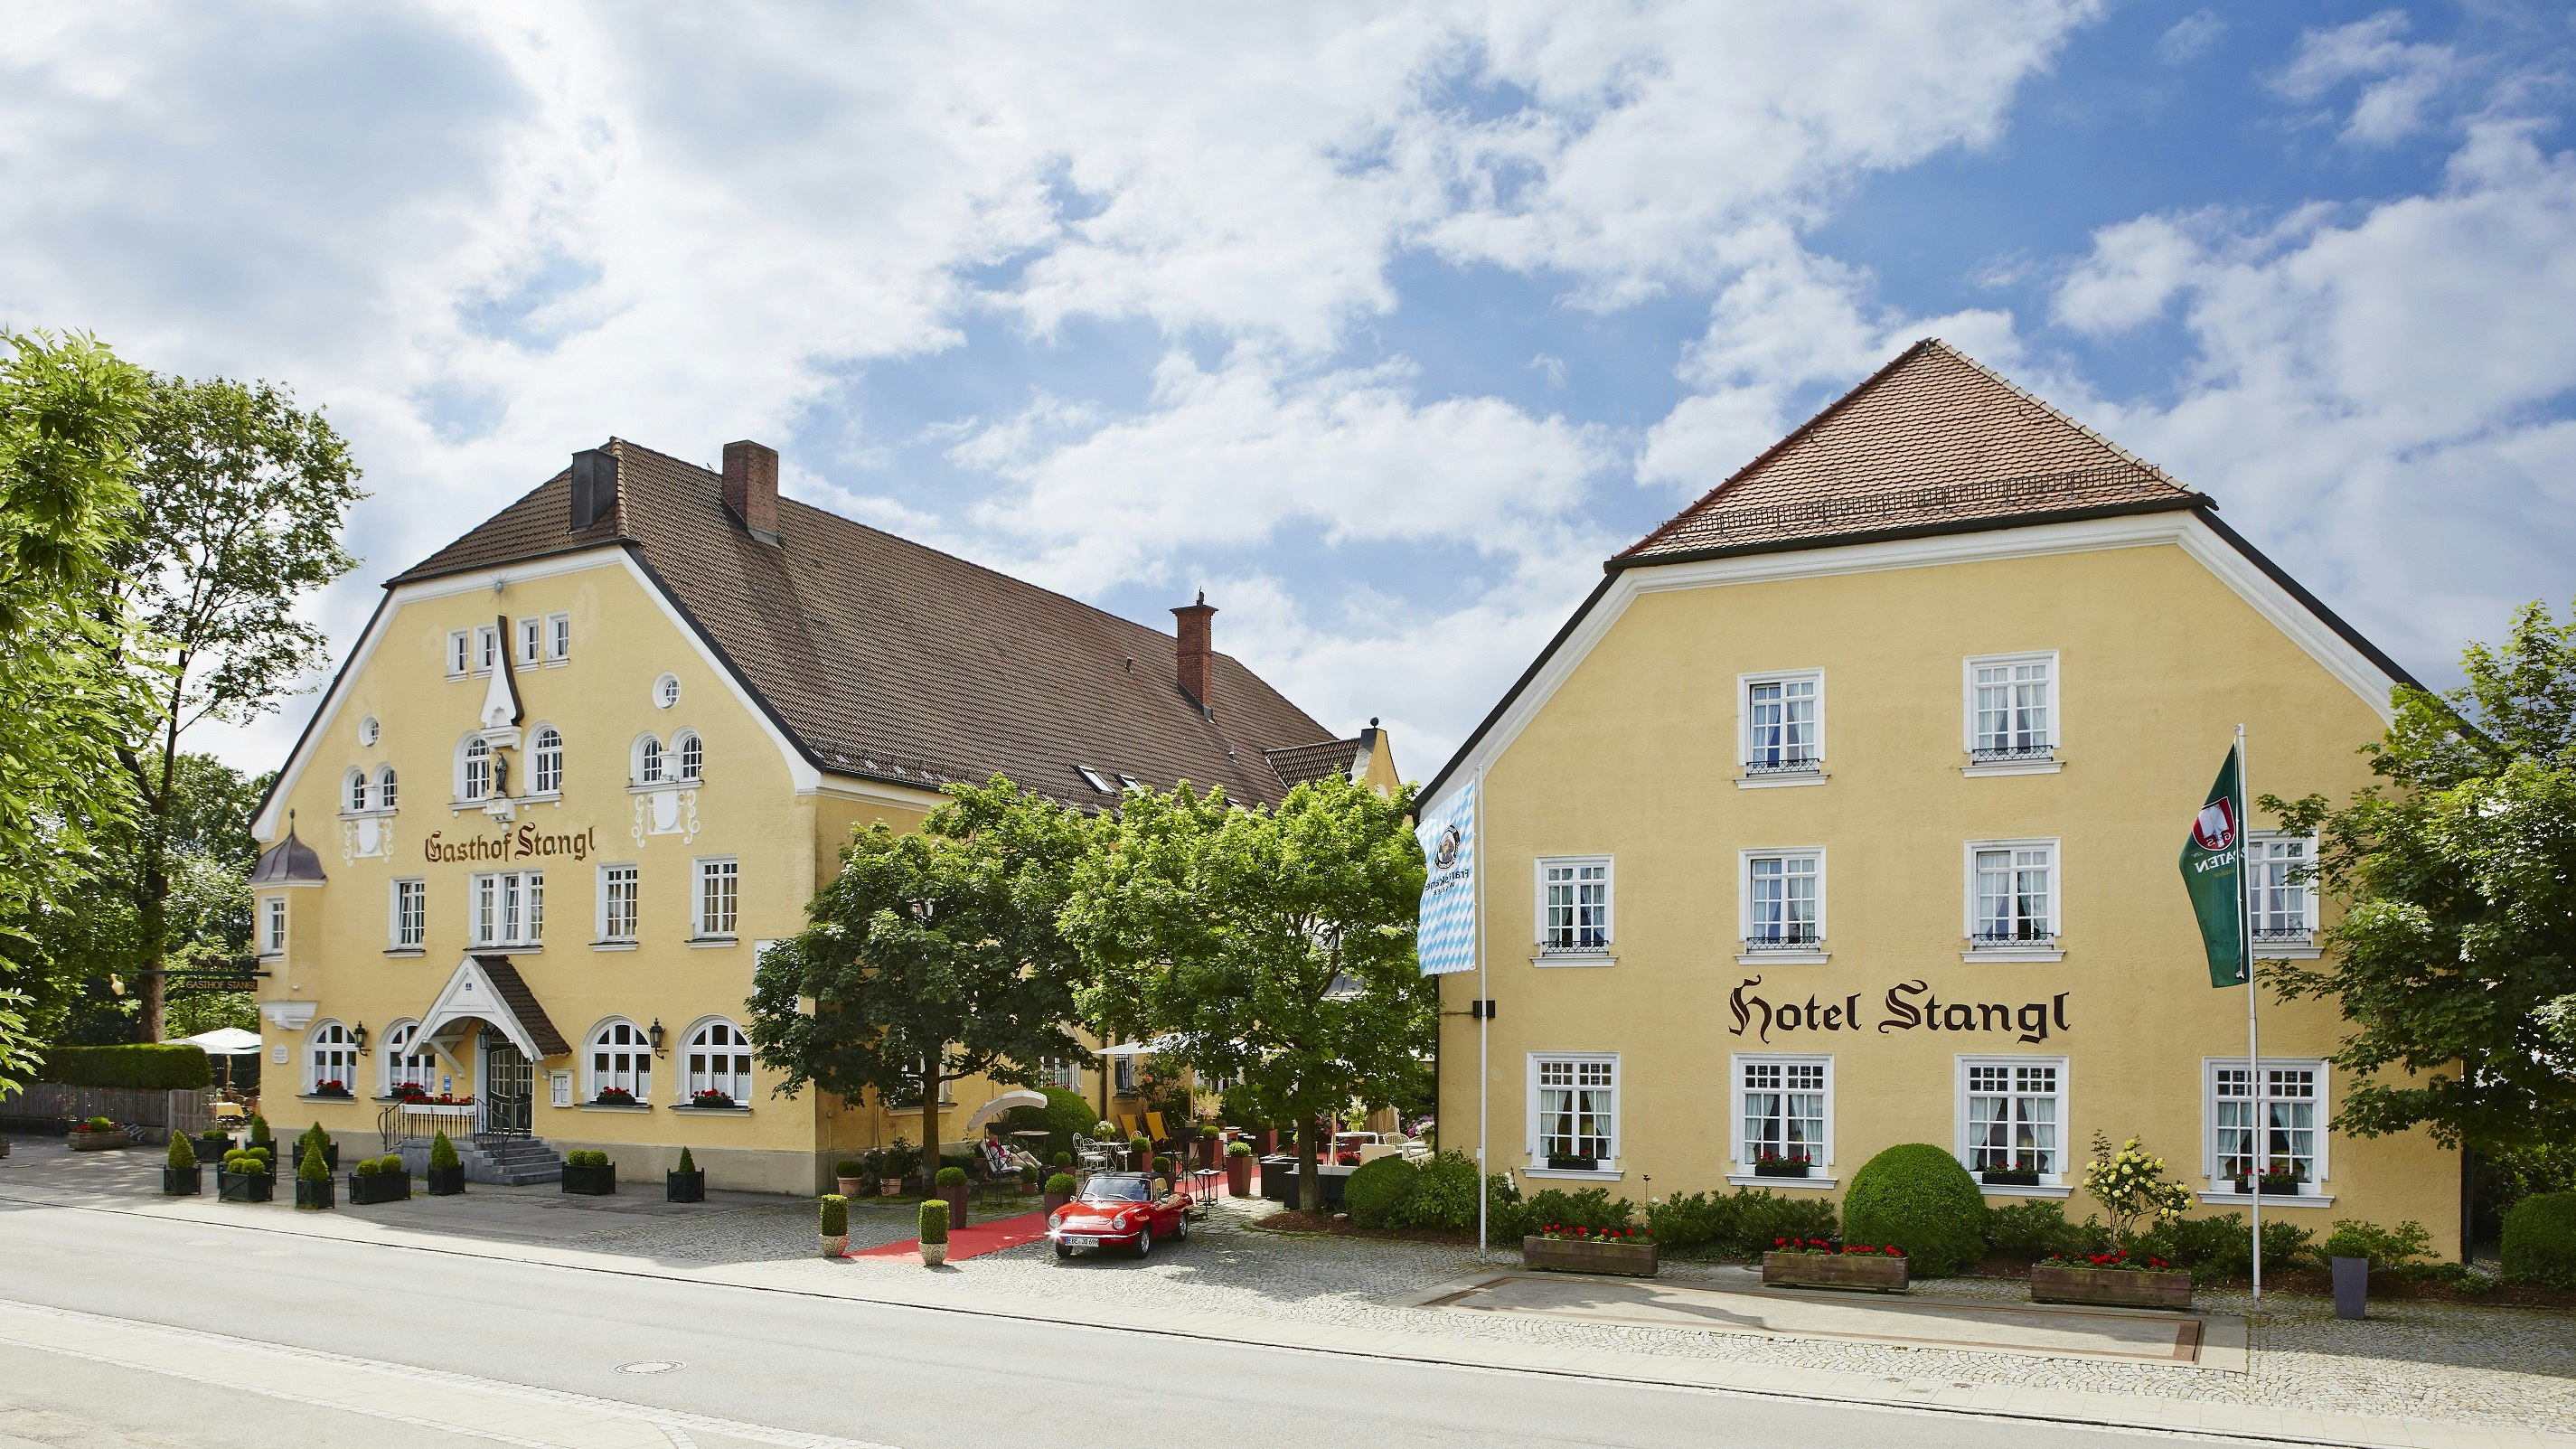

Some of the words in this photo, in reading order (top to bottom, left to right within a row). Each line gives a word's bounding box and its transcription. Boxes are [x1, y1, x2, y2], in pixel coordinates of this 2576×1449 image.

[425, 830, 512, 862] Gasthof
[514, 822, 596, 861] Stangl
[185, 981, 224, 989] GASTHOF
[227, 981, 258, 989] STANGL
[1728, 974, 1862, 1044] Hotel
[1877, 979, 2072, 1044] Stangl
